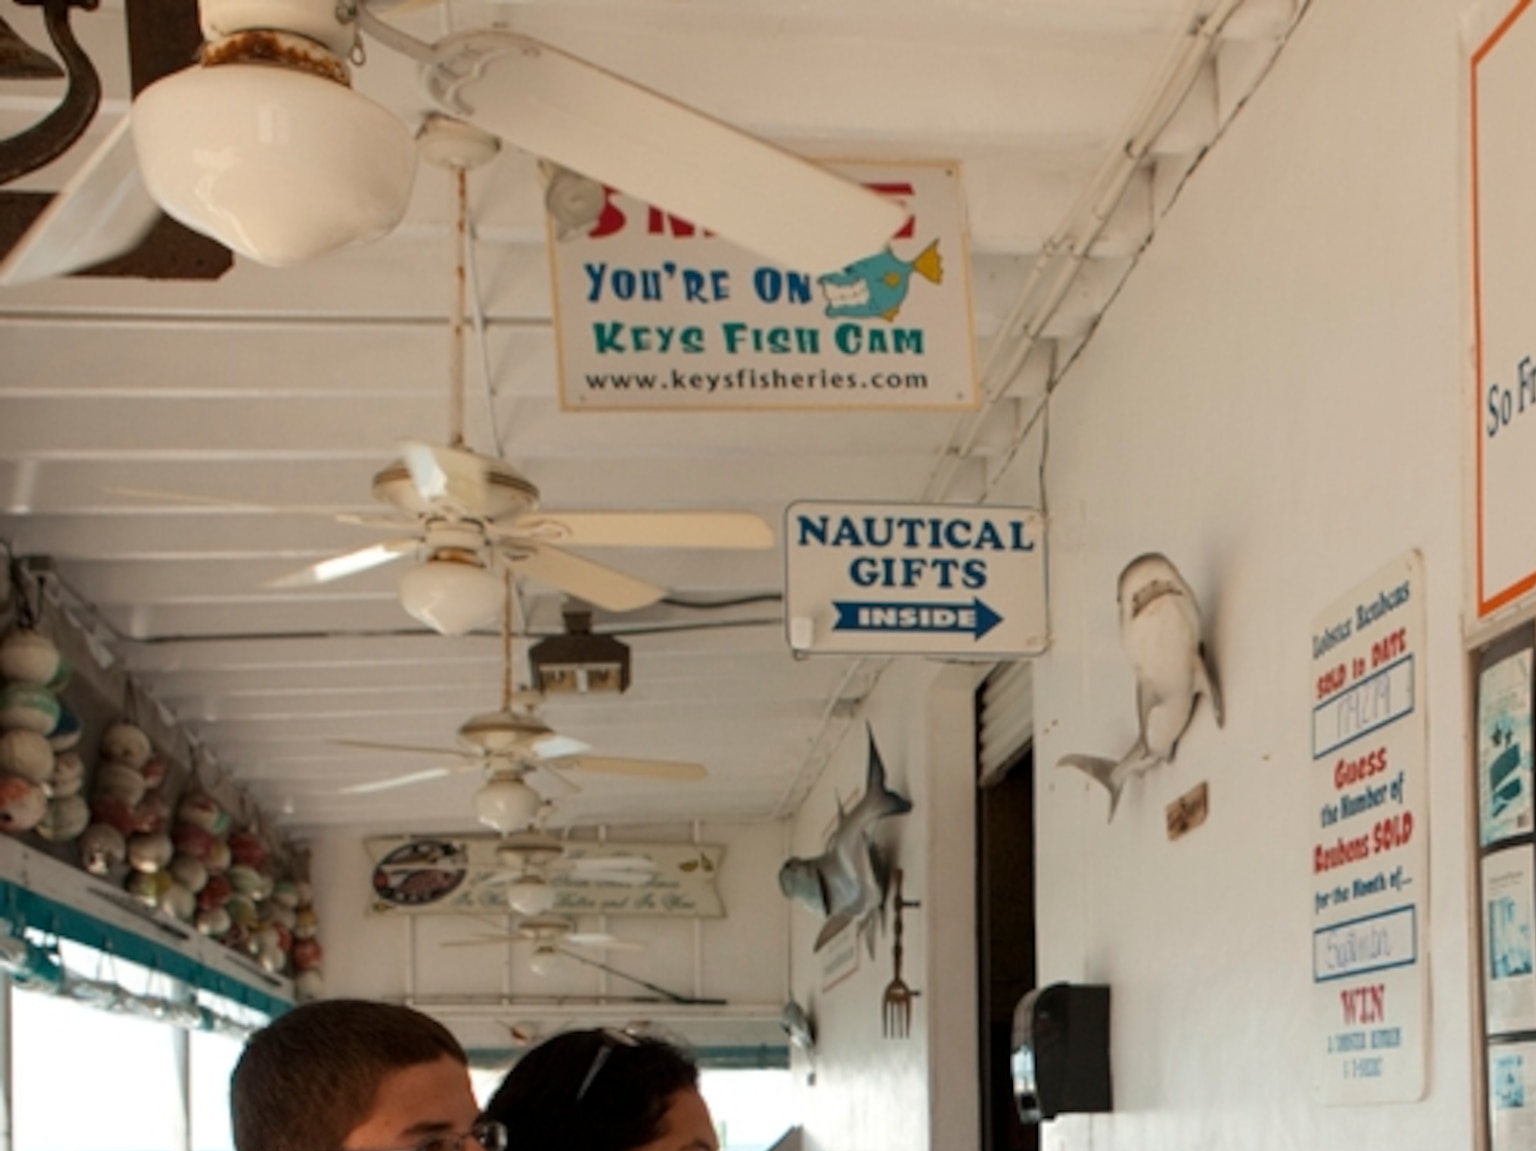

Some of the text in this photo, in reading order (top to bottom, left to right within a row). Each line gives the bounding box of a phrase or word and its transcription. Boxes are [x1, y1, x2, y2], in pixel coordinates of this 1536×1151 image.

[585, 368, 929, 393] www.keysfisheries.com
[1486, 384, 1512, 437] So
[797, 515, 1035, 551] NAUTICAL
[849, 556, 988, 588] GIFTS
[858, 606, 977, 629] INSIDE
[1317, 663, 1346, 700] SOLD
[1371, 626, 1406, 668] DATE
[1334, 746, 1387, 790] Guess
[1340, 784, 1388, 820] Number
[1373, 810, 1413, 854] SOLD
[1340, 983, 1386, 1025] WIN
